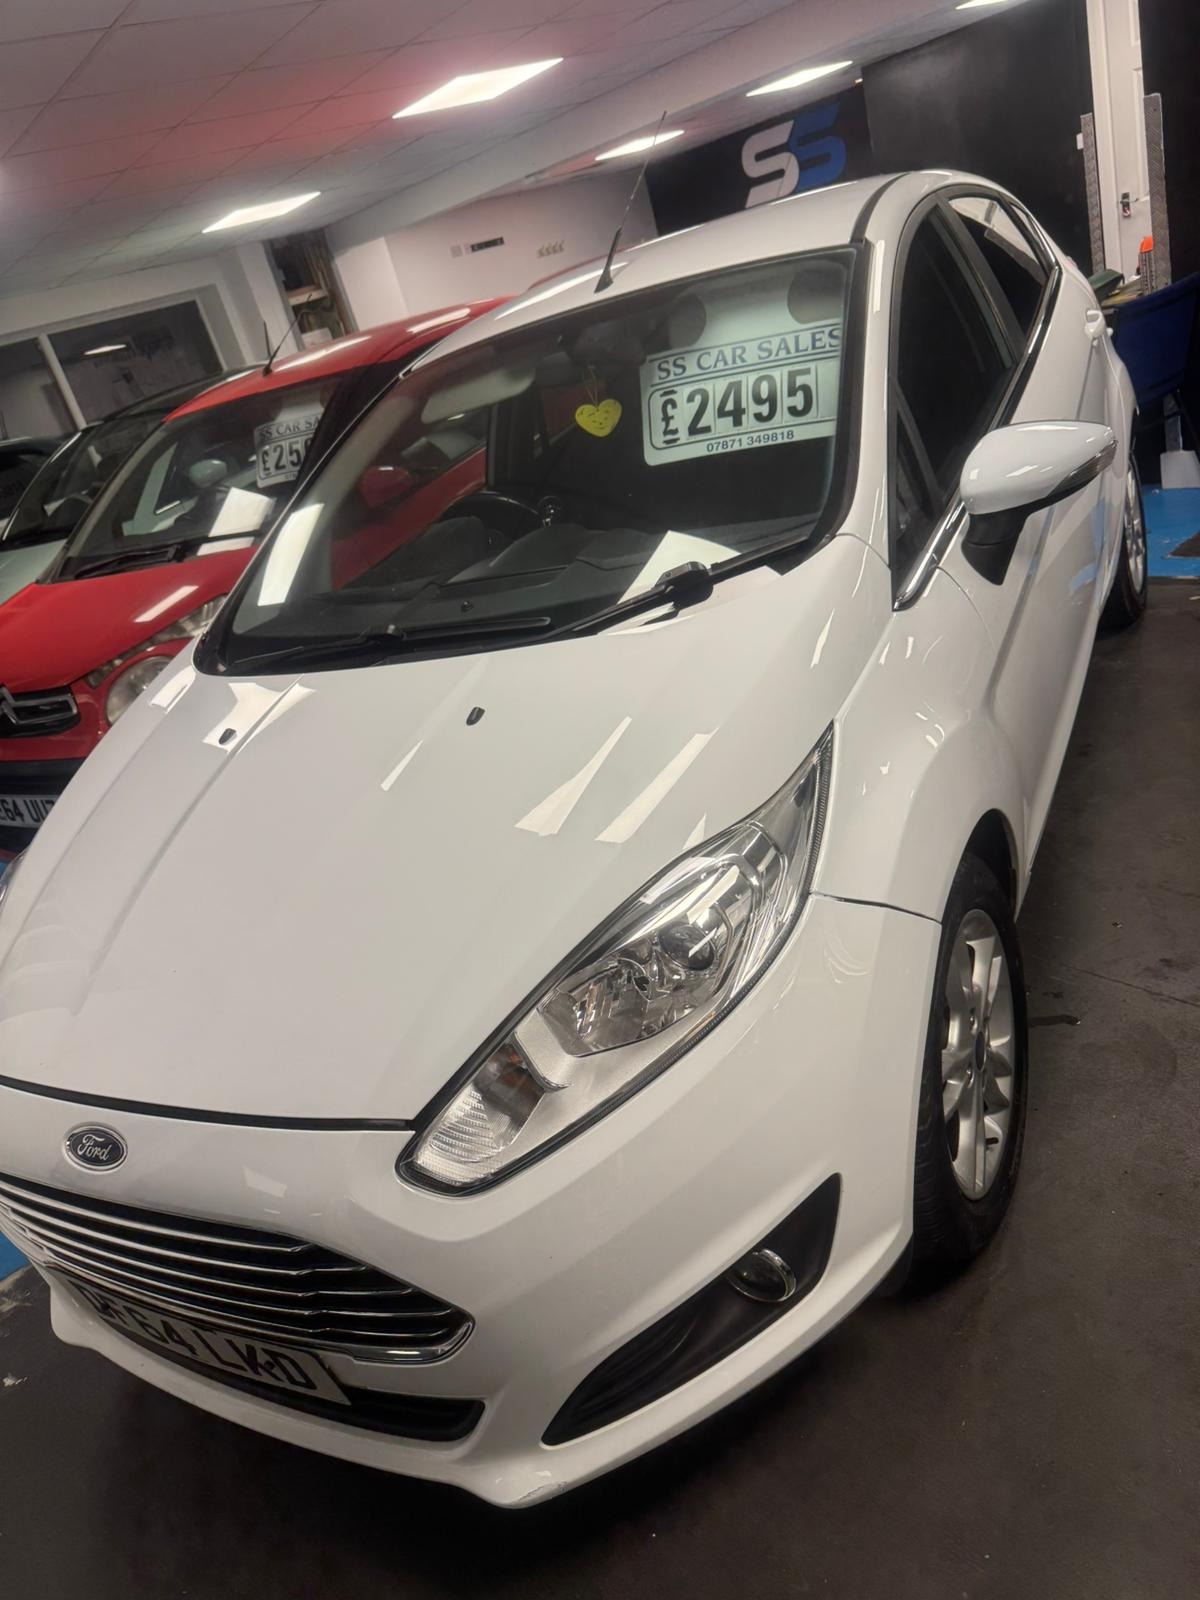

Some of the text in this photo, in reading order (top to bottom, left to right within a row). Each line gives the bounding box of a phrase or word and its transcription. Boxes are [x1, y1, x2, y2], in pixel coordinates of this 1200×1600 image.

[741, 103, 846, 208] SS
[657, 327, 842, 381] SS CAR SALES
[276, 421, 301, 436] CAR
[660, 367, 814, 440] £2495
[706, 430, 795, 453] 07871 349818
[77, 1134, 112, 1161] Ford
[191, 1329, 317, 1390] LKD
